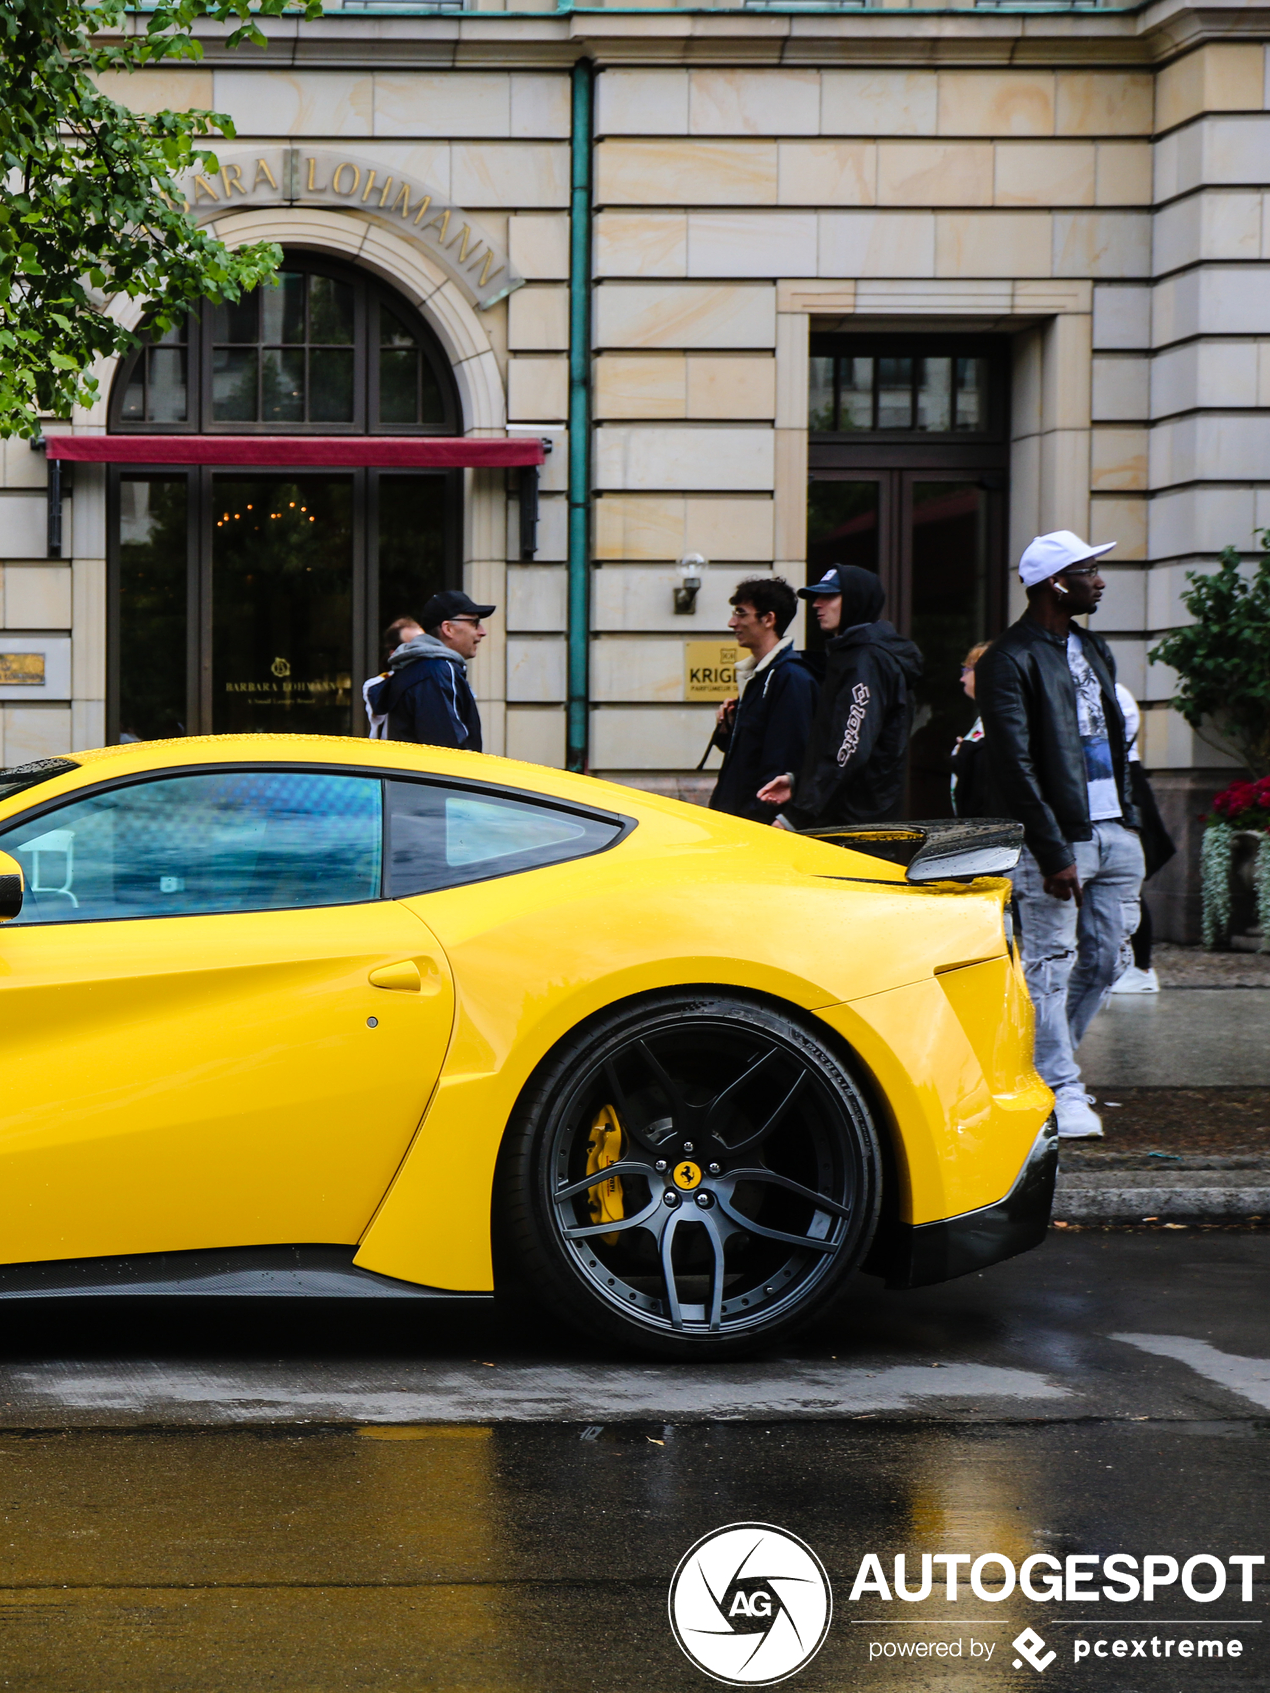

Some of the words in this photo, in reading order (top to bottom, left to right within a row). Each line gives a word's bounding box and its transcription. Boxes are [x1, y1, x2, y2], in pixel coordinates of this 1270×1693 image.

[306, 157, 505, 288] LOHMANN
[226, 682, 278, 692] BARBARA
[690, 668, 737, 683] KRIGL
[806, 1042, 854, 1097] MICHELIN
